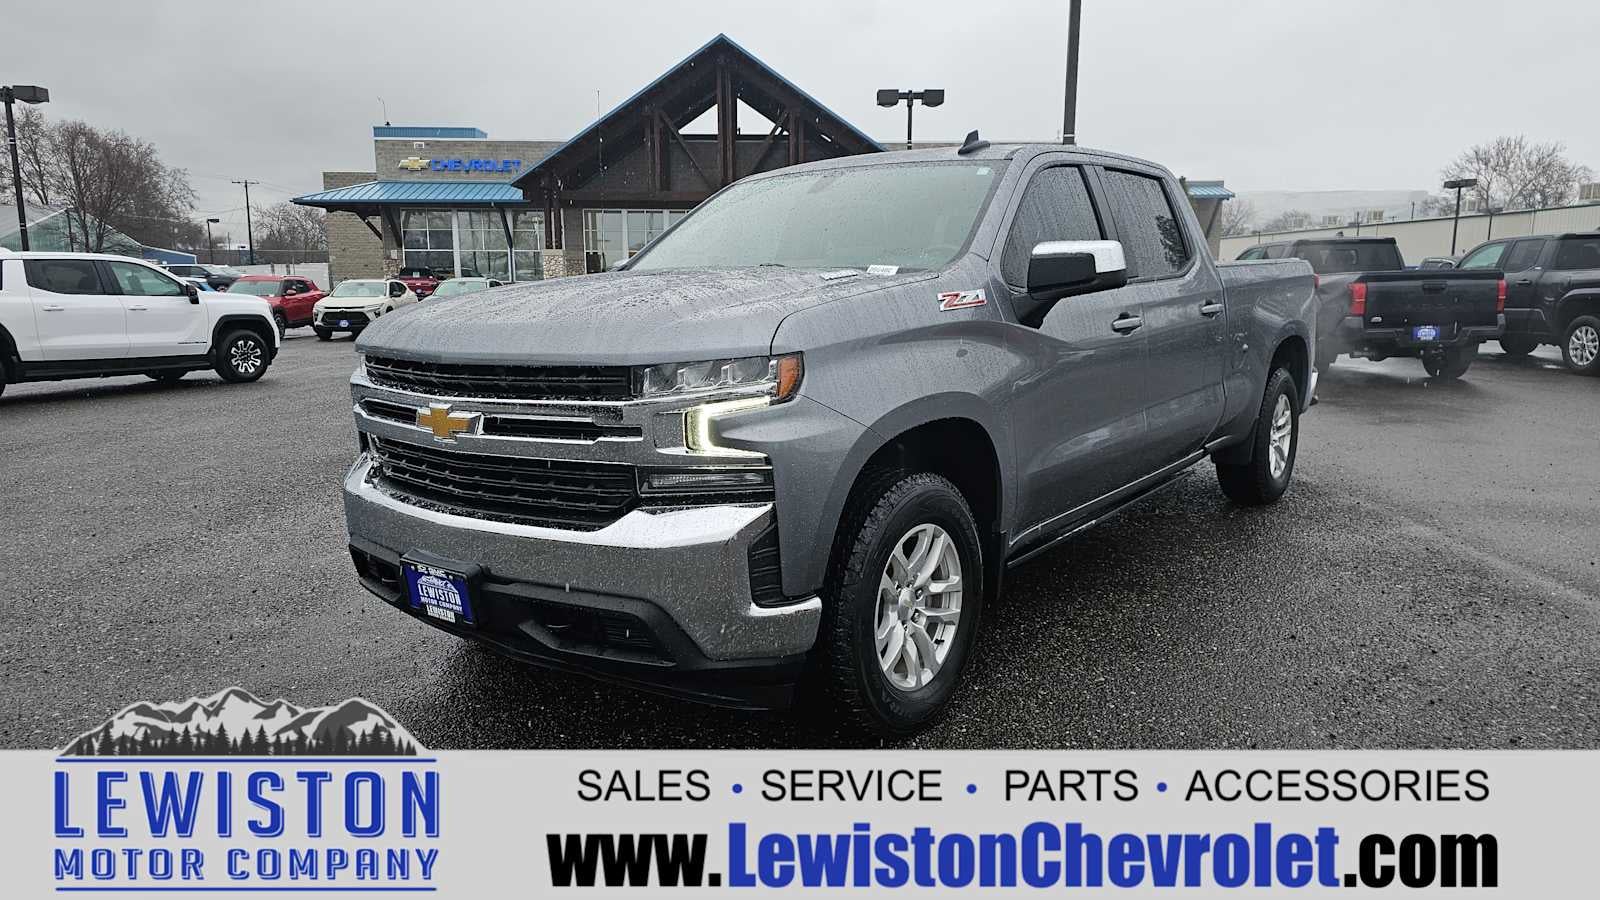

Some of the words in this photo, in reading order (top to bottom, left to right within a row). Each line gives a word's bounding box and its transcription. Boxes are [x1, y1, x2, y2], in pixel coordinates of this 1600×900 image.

[431, 159, 520, 172] CHEVROLET
[937, 288, 987, 312] Z71
[418, 583, 461, 606] LEWISTON
